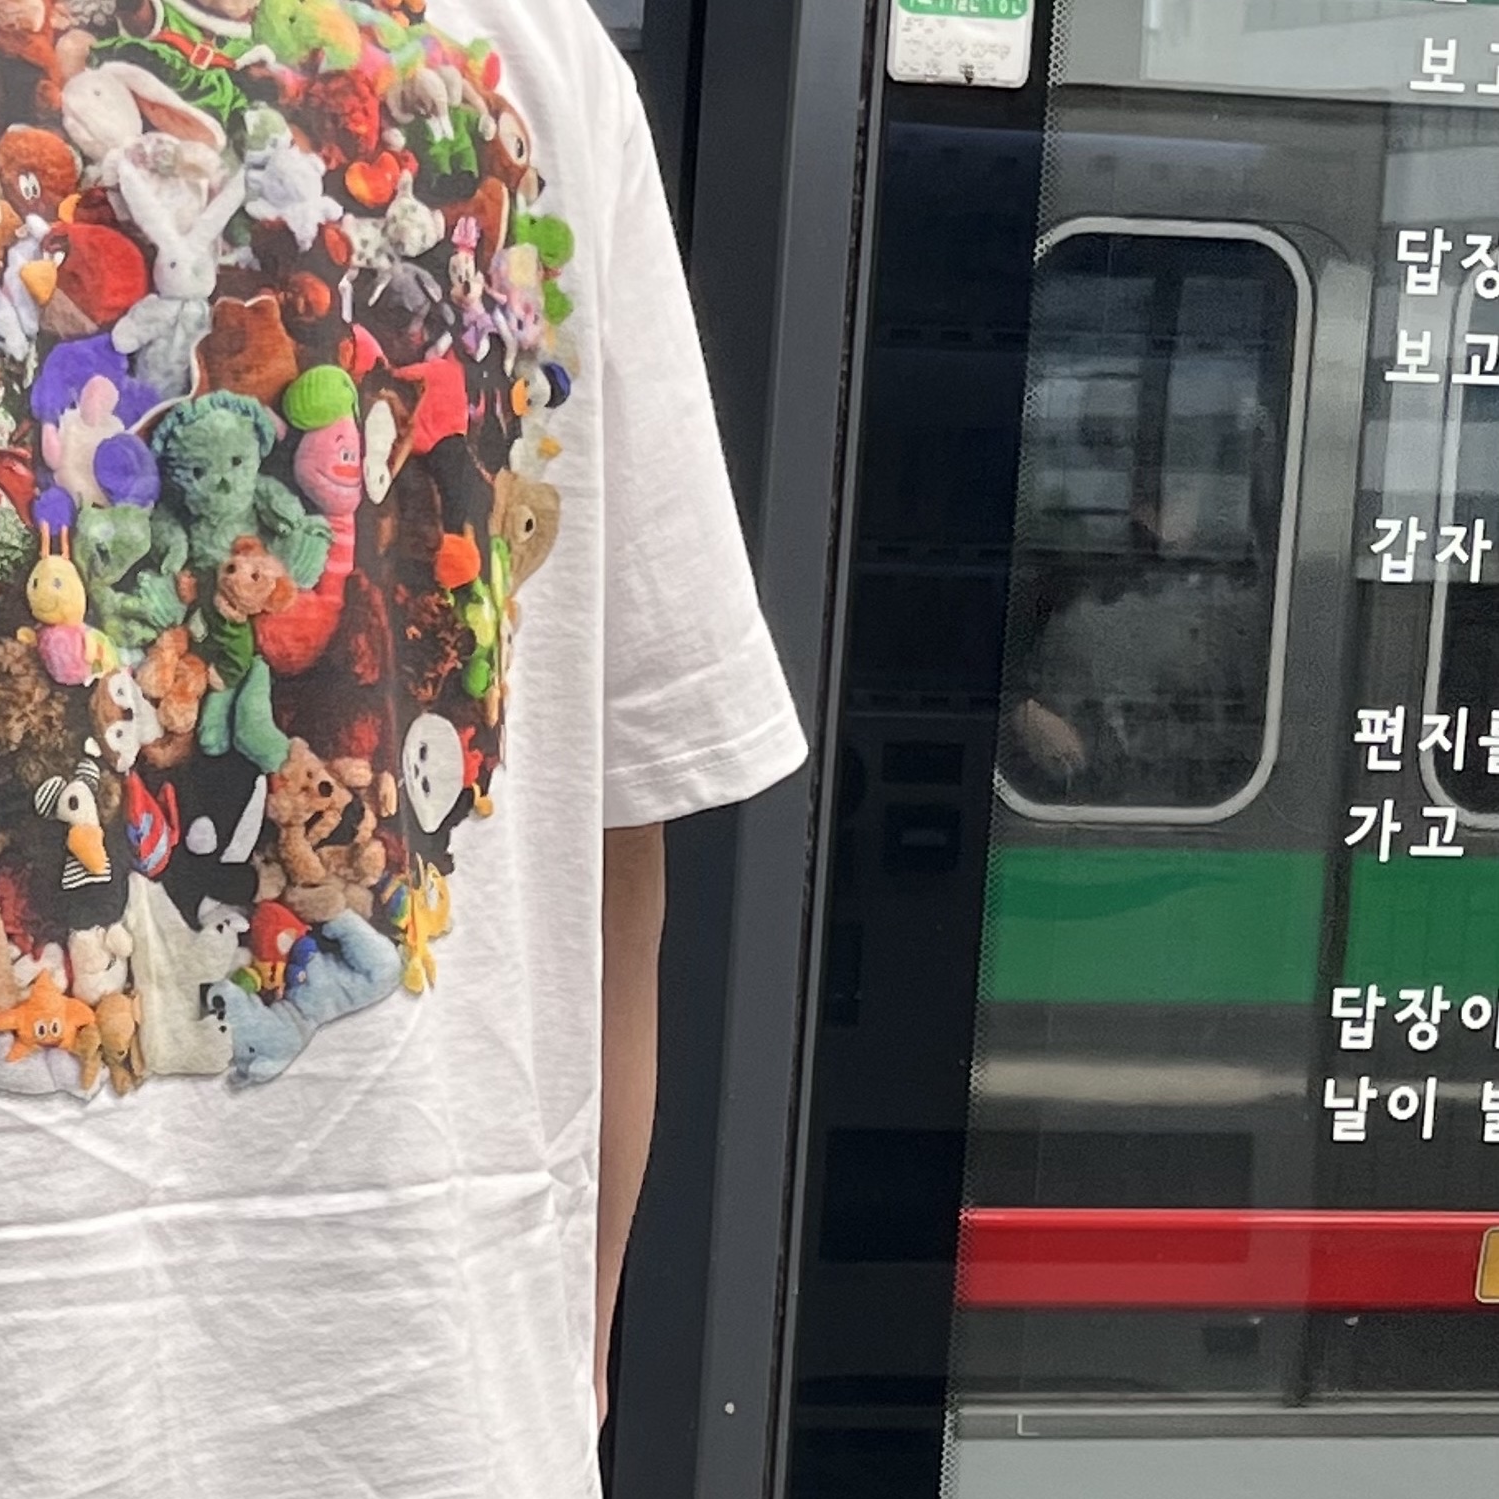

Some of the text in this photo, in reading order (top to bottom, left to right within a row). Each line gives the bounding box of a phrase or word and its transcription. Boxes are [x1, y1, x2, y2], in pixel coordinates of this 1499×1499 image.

[1369, 516, 1493, 583] 갑자
[1344, 798, 1465, 863] 가고
[1323, 1075, 1438, 1142] 날이
